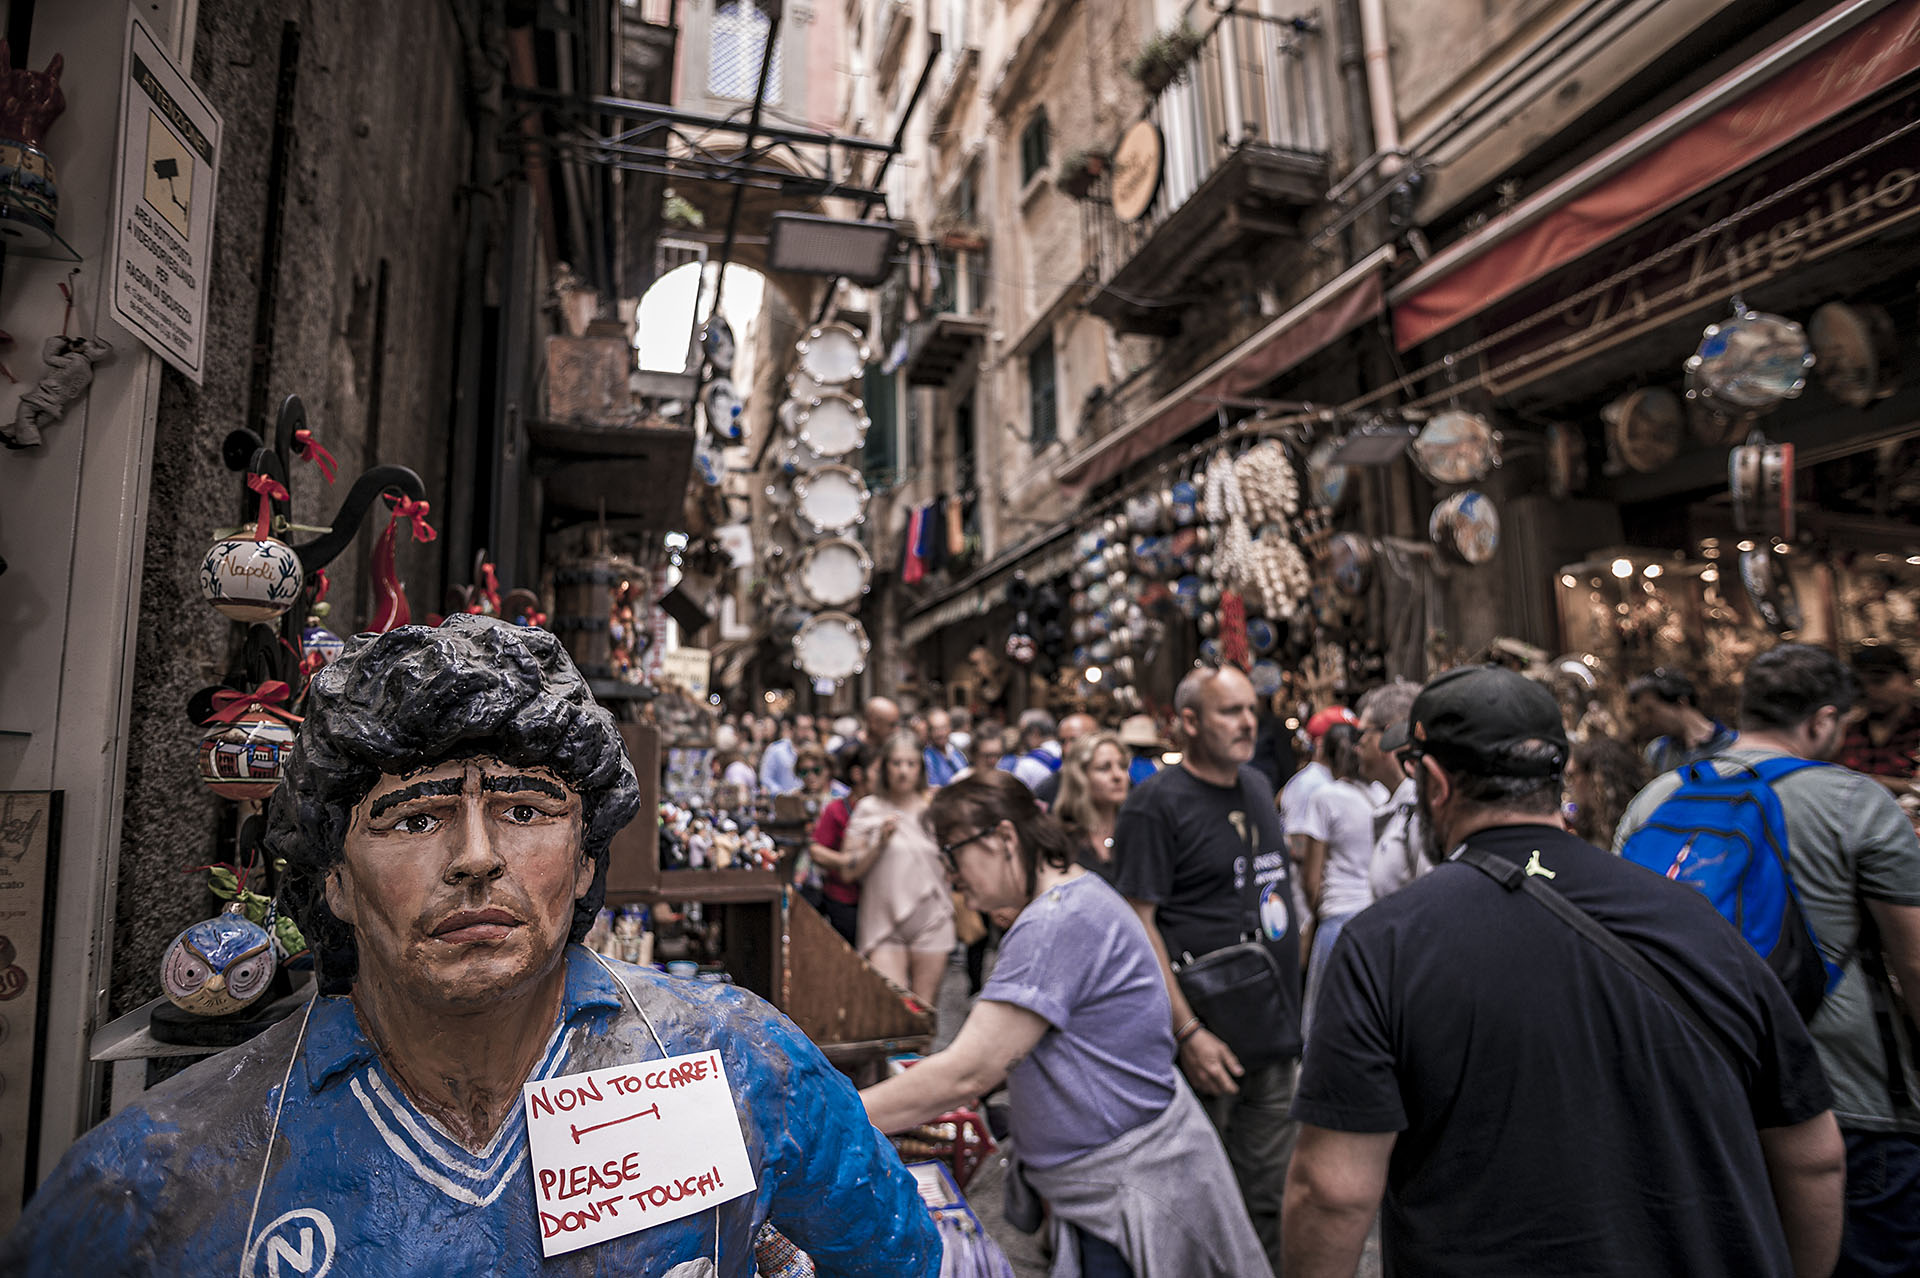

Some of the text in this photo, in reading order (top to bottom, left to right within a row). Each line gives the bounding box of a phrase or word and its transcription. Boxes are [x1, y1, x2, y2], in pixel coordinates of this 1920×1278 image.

[127, 218, 132, 233] A
[135, 204, 192, 268] AREA SOTTOPOSTA
[1656, 166, 1916, 298] Virgilio
[126, 259, 152, 292] RAGIONI
[153, 283, 160, 298] DI
[161, 290, 192, 324] SICUREZZA
[155, 264, 169, 286] PER
[220, 555, 276, 590] Napoli
[531, 1056, 718, 1119] NON TOCCARE!
[538, 1152, 641, 1201] PLEASE
[540, 1166, 724, 1238] DON'T TOUCH!
[267, 1227, 314, 1278] N
